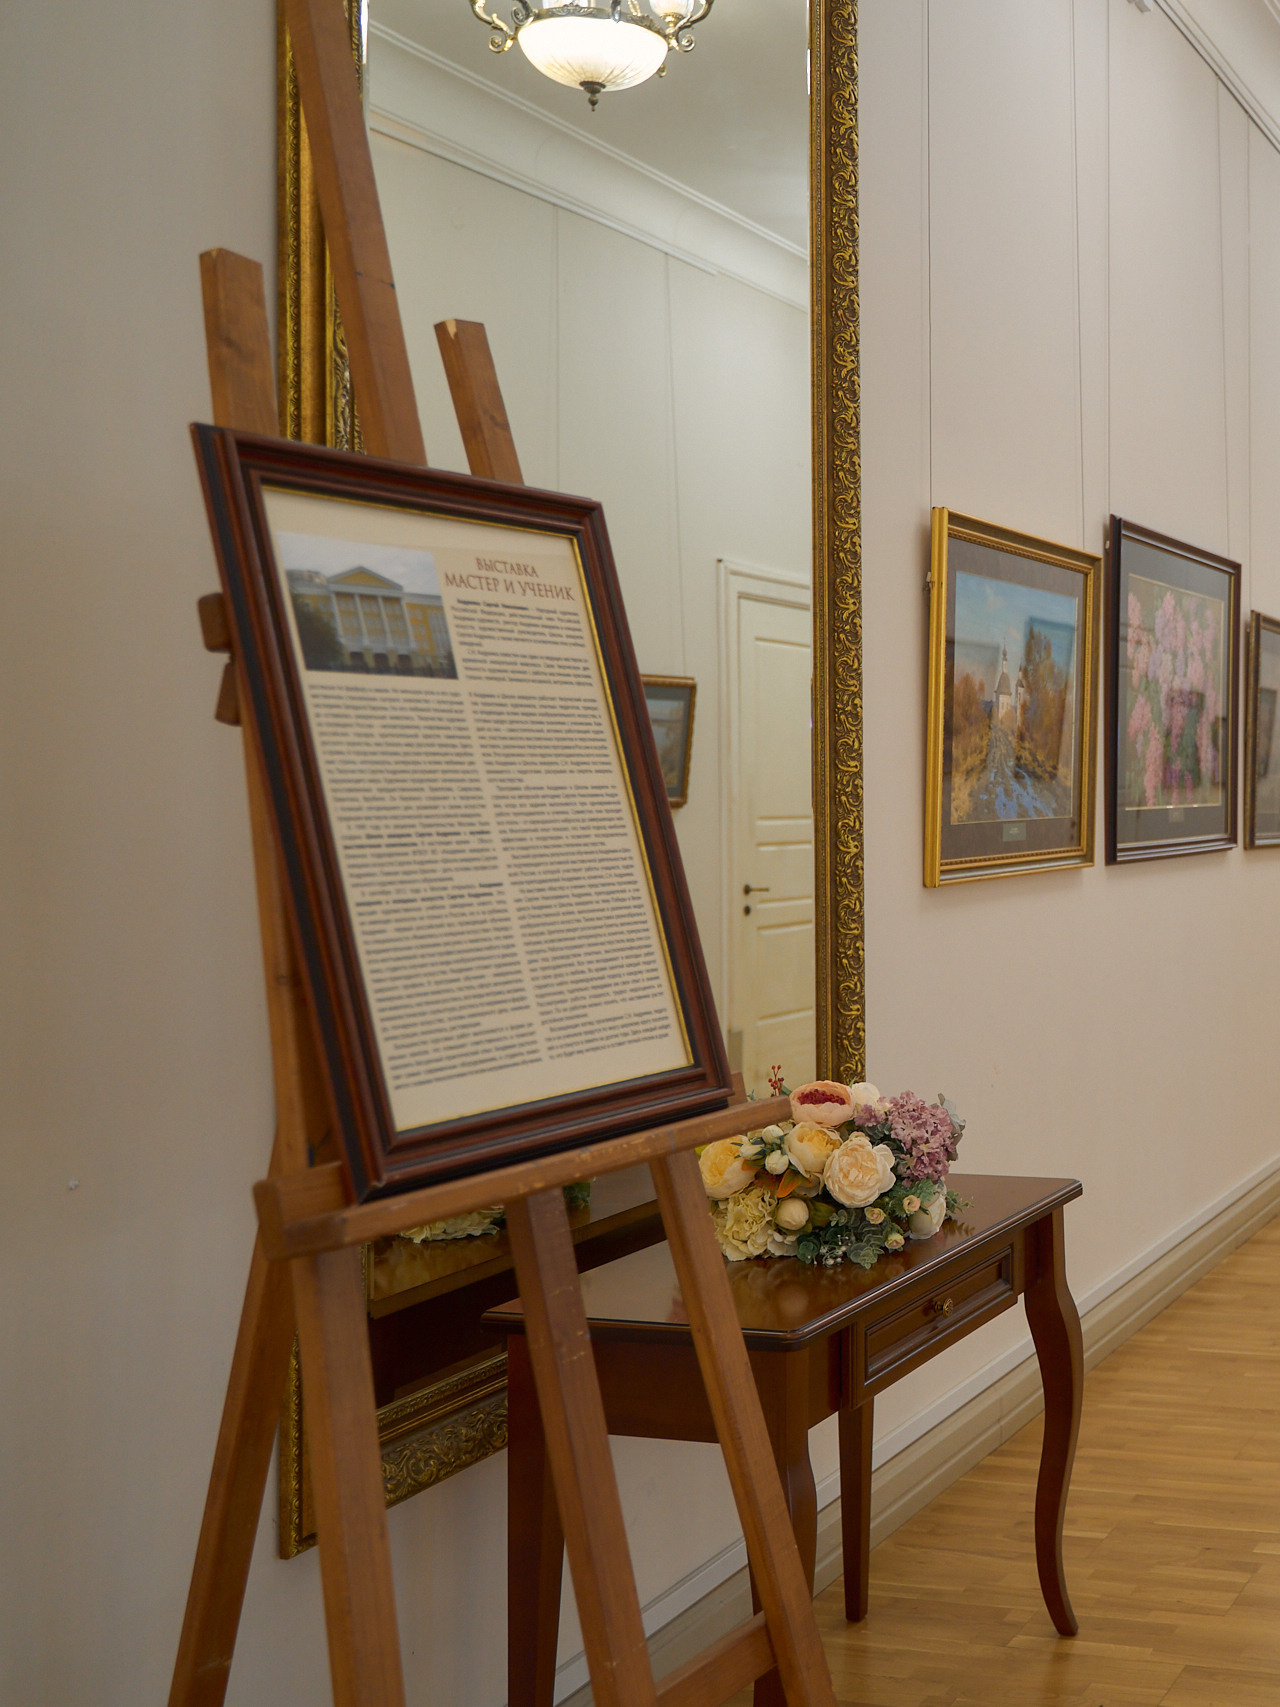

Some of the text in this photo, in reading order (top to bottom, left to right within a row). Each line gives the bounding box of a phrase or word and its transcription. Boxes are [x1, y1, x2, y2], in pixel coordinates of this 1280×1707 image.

[475, 557, 539, 578] ВЫСТАВКА
[444, 573, 575, 601] МАСТЕР И УЧЕНИК
